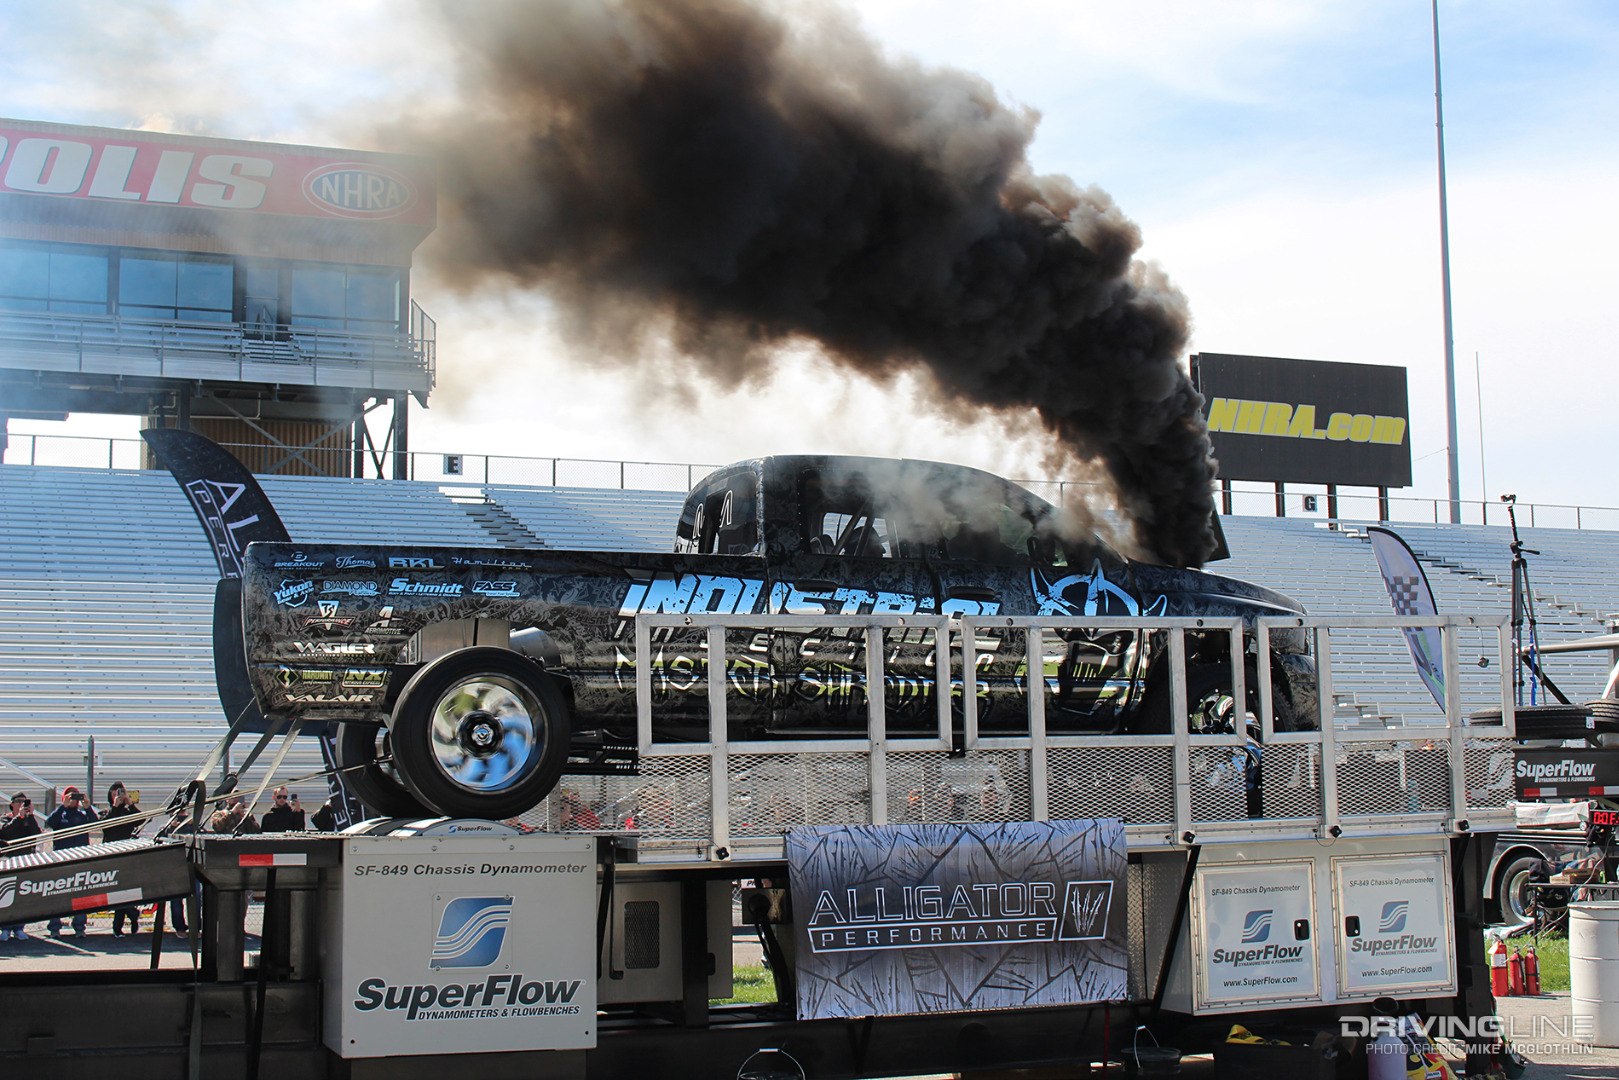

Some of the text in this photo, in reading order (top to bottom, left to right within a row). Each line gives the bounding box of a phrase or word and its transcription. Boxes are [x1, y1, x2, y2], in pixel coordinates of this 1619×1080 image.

[0, 135, 274, 209] OLIS
[321, 175, 400, 209] NHRA
[1206, 397, 1407, 446] NHRA.com
[447, 456, 459, 473] E
[1304, 496, 1316, 511] G
[336, 555, 376, 568] Thomas
[451, 557, 532, 568] Hamilton
[273, 580, 314, 600] Yukon
[323, 581, 378, 591] DIAMOND
[389, 578, 464, 593] Schmidt
[473, 581, 516, 592] FASS
[293, 642, 376, 654] WAGLER
[345, 669, 383, 680] NX
[1516, 760, 1597, 782] SuperFlow
[354, 863, 587, 876] SF-849 Chassis Dynamometer
[19, 870, 118, 897] SuperFlow
[1371, 878, 1393, 887] Chassis
[1394, 876, 1435, 887] Dynamometer
[1211, 884, 1301, 896] SF-849 Chassis Dynamometer
[809, 882, 1057, 926] ALLIGATOR
[821, 923, 1047, 947] PERFORMANCE
[1351, 934, 1438, 956] SuperFlow
[1212, 944, 1303, 967] SuperFlow
[1361, 966, 1433, 977] www.SuperFlow.com
[1223, 976, 1298, 988] www.SuperFlow.com
[354, 973, 583, 1021] SuperFlow
[418, 1006, 580, 1020] DYNAMOMETERS & FLOWBENCHES
